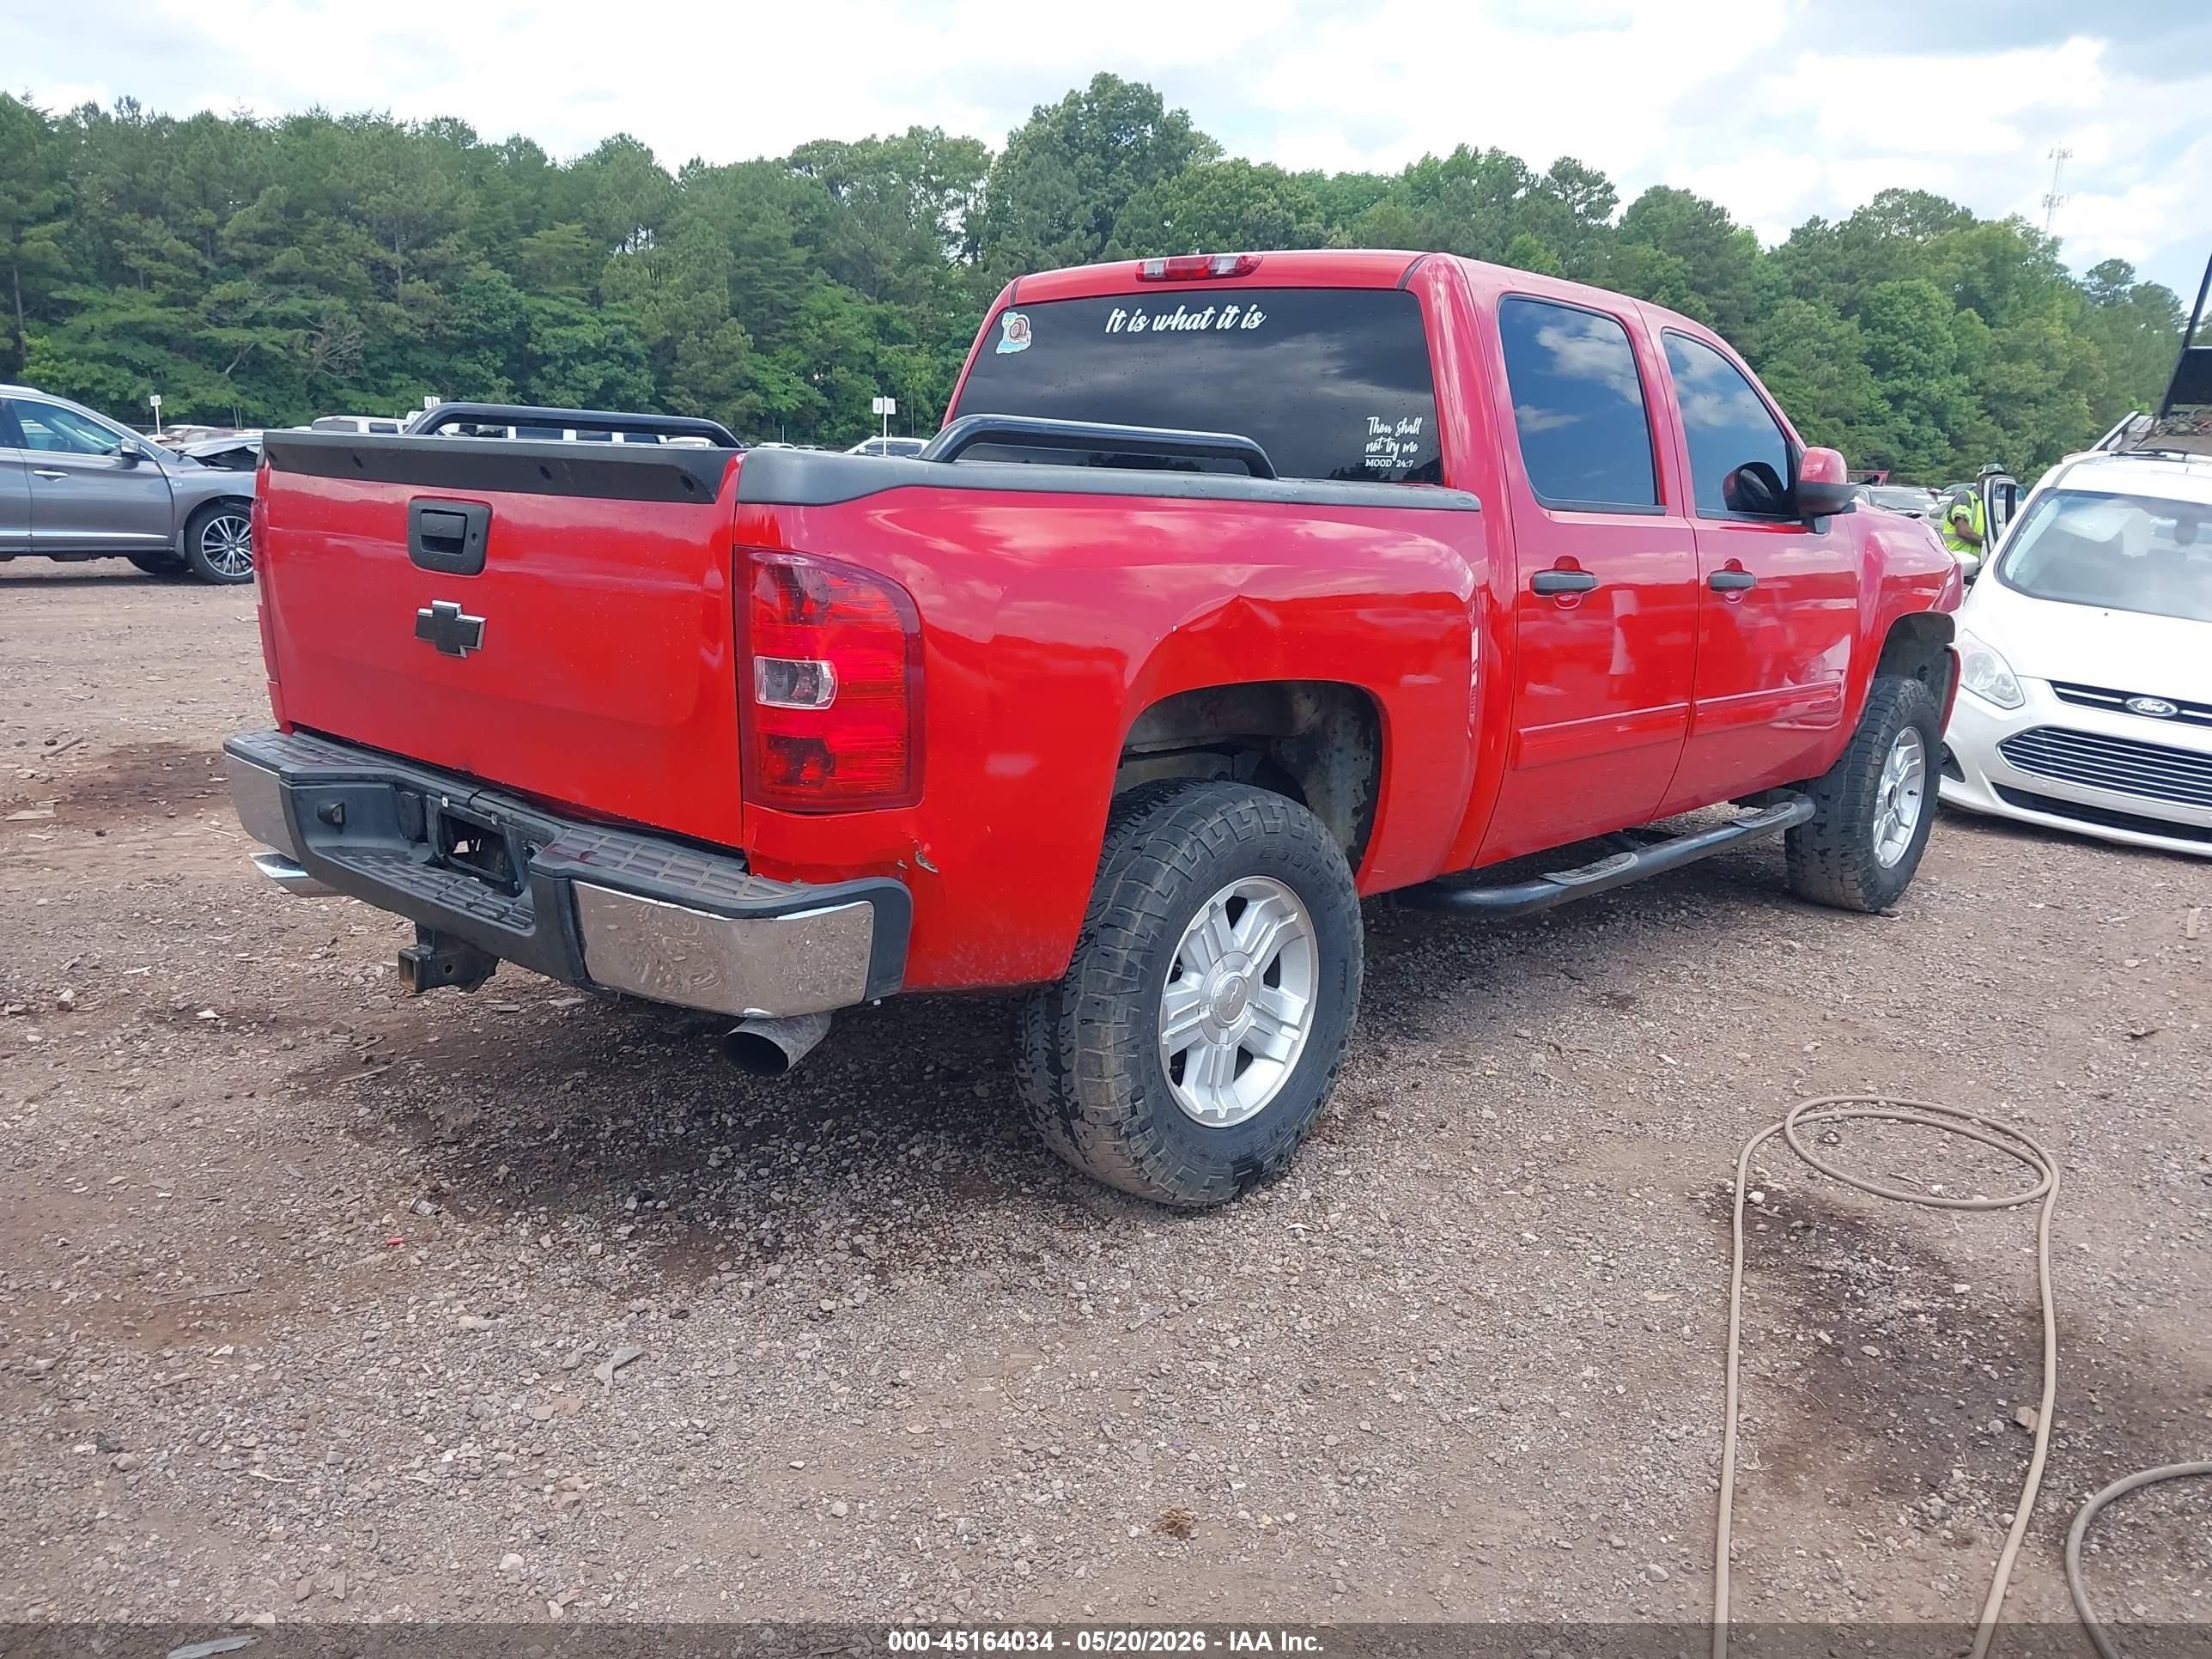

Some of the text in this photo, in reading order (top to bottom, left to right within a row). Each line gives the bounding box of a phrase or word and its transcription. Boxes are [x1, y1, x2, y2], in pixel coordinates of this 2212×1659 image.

[1105, 303, 1267, 333] It is what it is
[1367, 416, 1422, 436] Thou shall
[1365, 436, 1419, 461] not try me
[1364, 459, 1413, 468] MOOD 24:7
